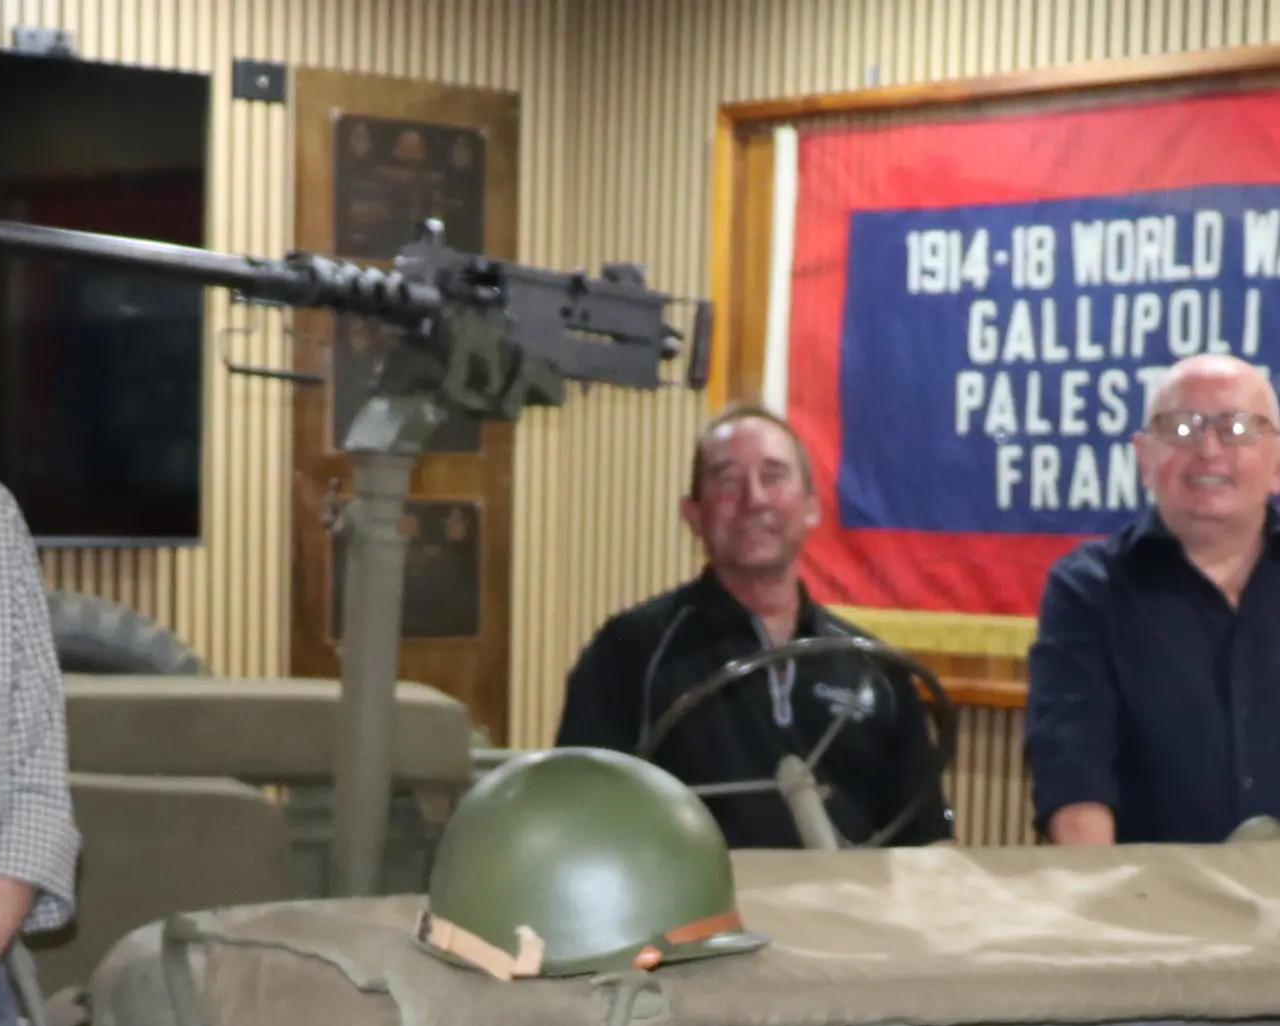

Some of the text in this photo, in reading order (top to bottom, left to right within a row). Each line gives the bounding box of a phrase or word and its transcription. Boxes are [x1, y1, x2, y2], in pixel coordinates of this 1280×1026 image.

[1070, 209, 1224, 287] WORLD
[967, 287, 1261, 365] GALLIPOLI
[954, 364, 1162, 437] PALEST
[995, 443, 1144, 512] FRAN
